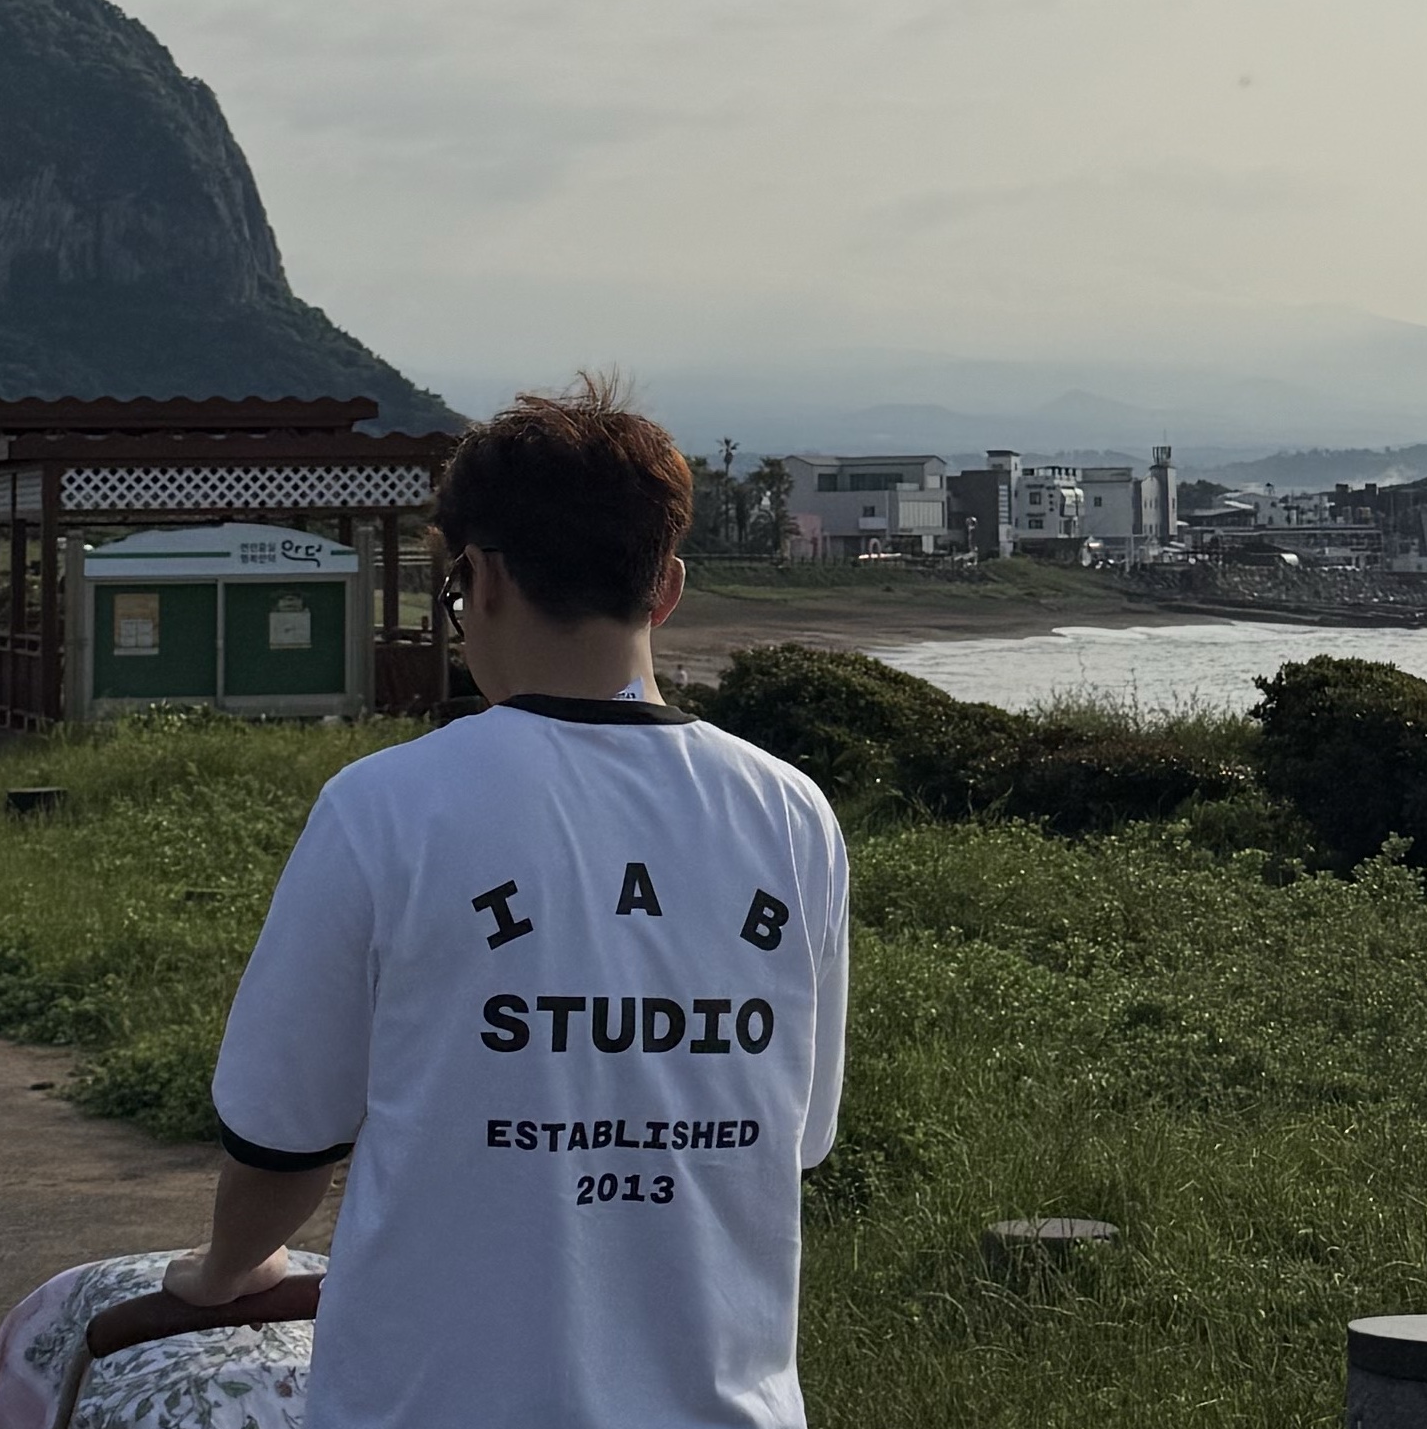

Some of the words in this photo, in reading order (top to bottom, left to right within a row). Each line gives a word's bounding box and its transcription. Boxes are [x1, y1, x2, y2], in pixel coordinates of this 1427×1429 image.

[480, 994, 775, 1055] STUDIO
[487, 1120, 761, 1153] ESTABLISHED
[576, 1173, 676, 1207] 2013
